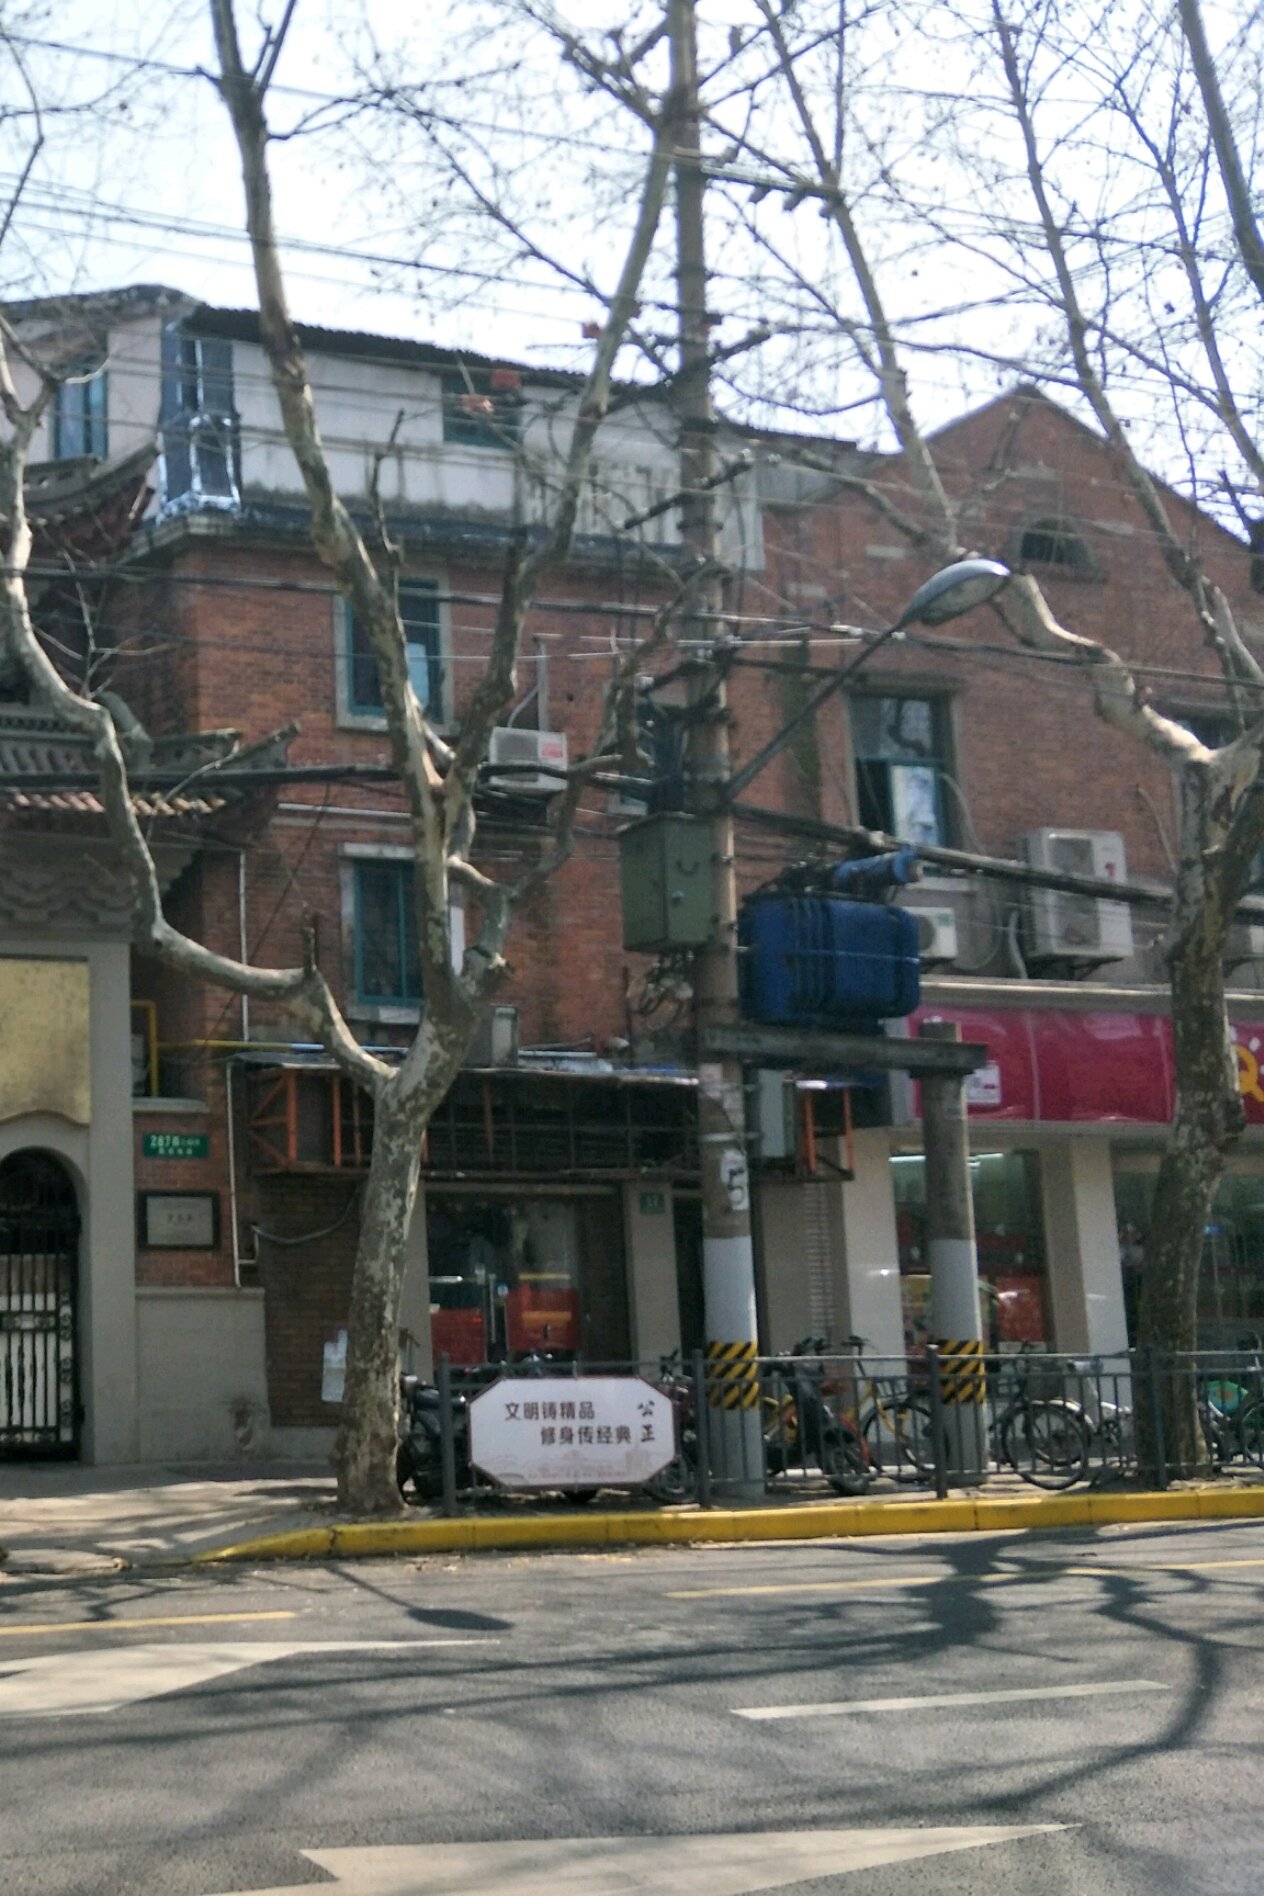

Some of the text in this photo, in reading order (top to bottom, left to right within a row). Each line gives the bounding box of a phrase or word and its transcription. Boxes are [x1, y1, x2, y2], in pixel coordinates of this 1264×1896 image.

[505, 1402, 595, 1420] 文明铸精品
[541, 1425, 632, 1445] 修身传经典
